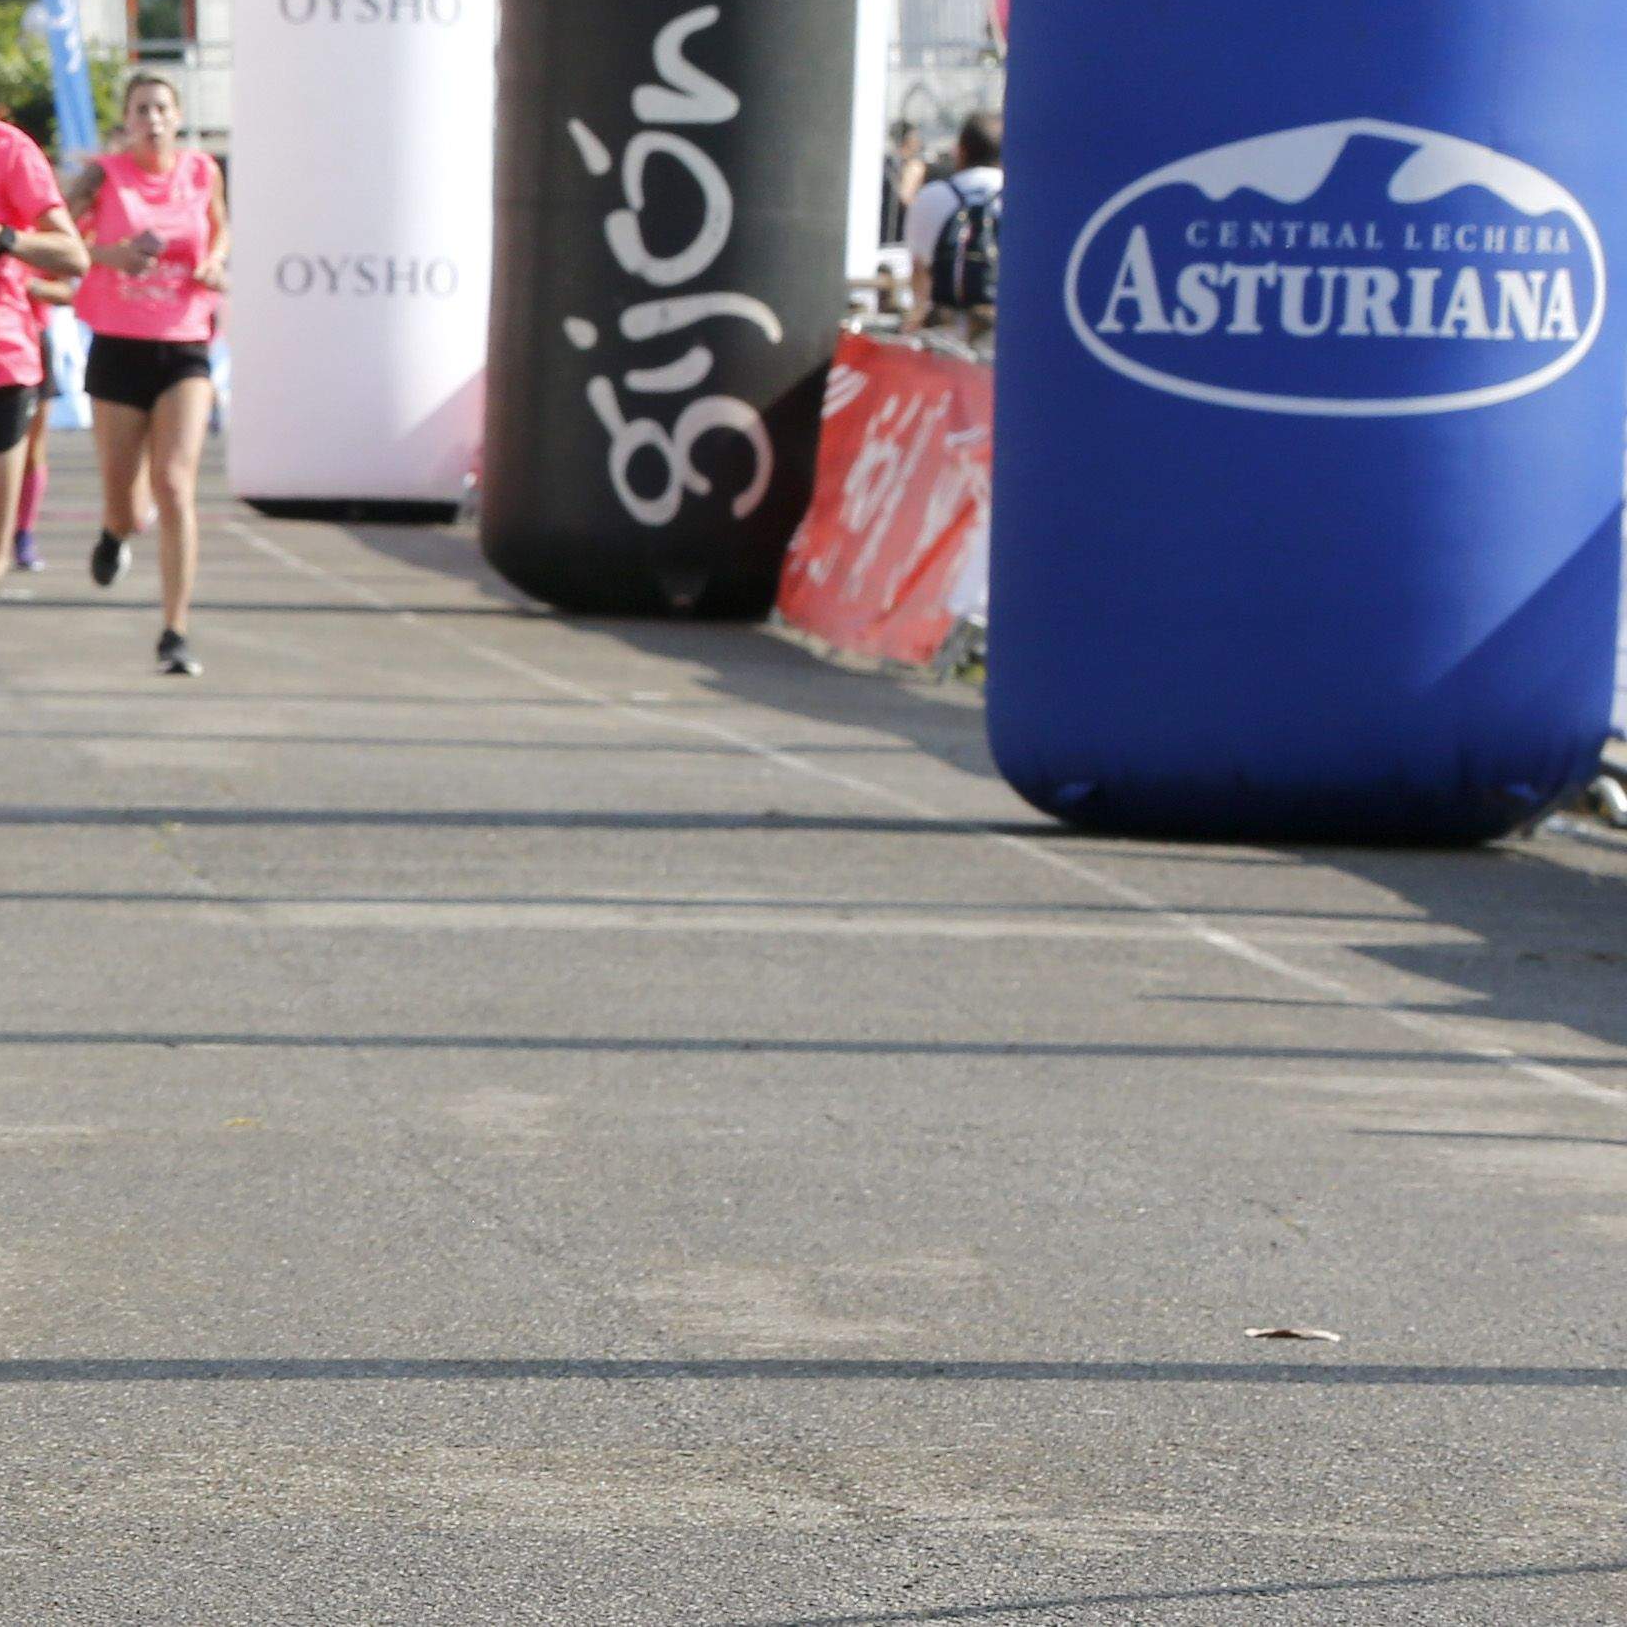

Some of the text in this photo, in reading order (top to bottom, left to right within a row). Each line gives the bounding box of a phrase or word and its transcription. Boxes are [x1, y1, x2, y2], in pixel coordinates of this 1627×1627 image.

[274, 254, 460, 298] OYSHO
[563, 3, 784, 528] gijón
[1185, 219, 1573, 255] CENTRAL LECHERA
[1096, 224, 1581, 342] ASTURIANA
